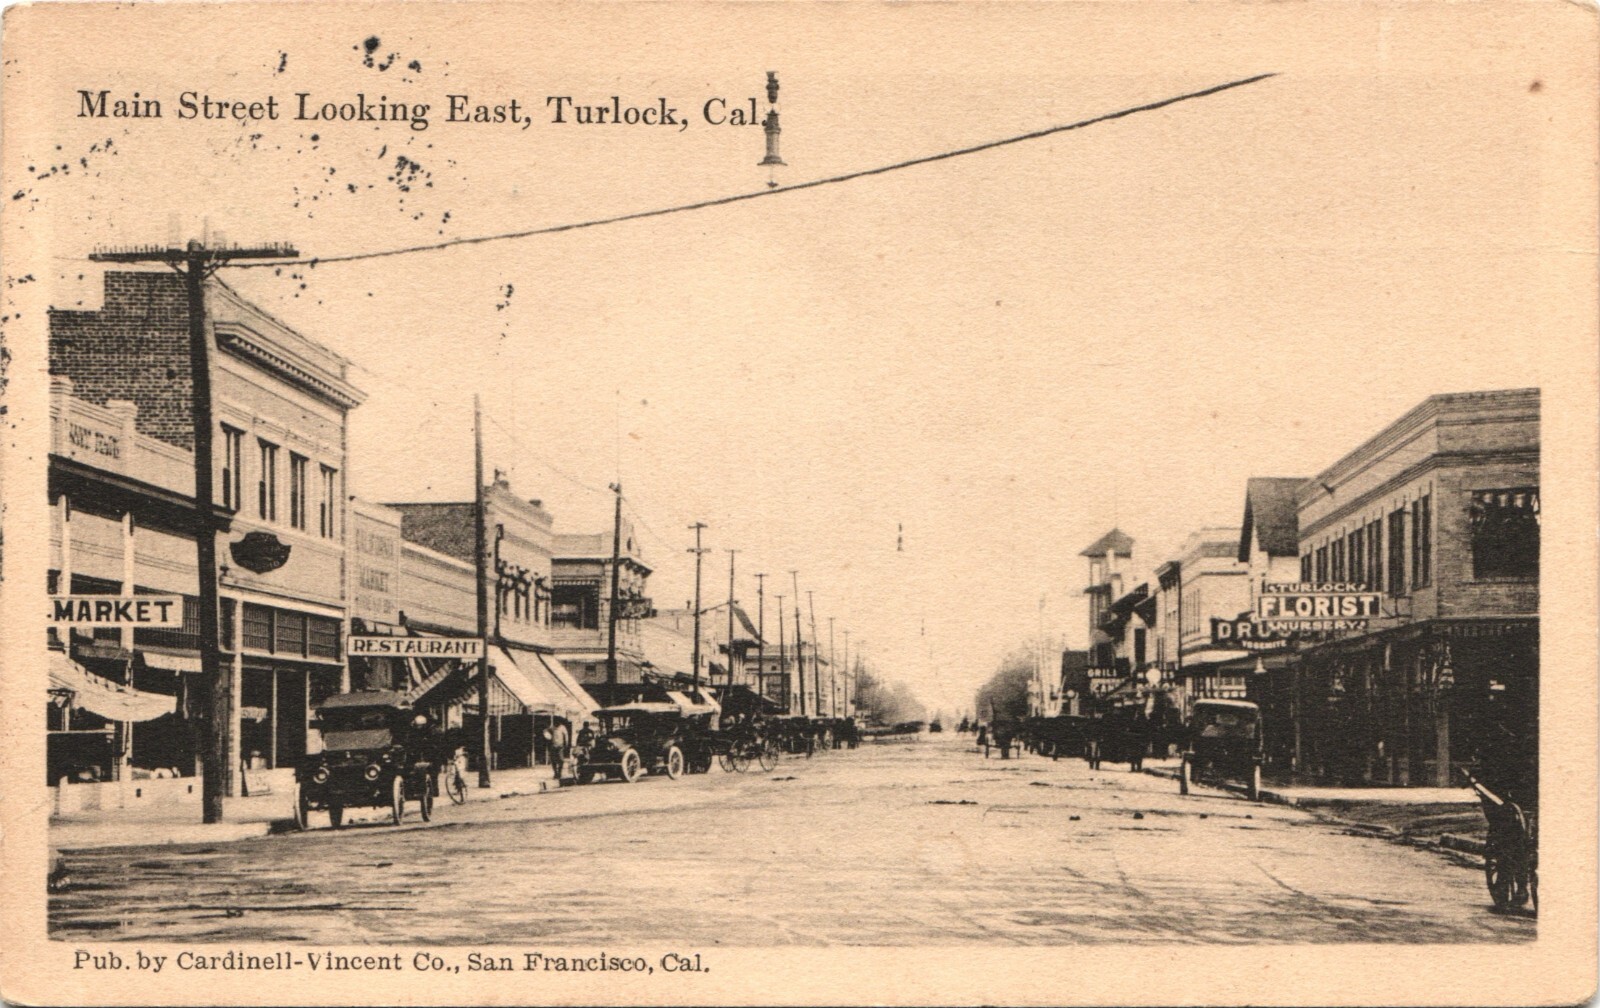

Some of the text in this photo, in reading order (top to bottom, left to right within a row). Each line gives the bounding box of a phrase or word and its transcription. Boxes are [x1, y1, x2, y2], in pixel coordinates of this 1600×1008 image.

[1278, 582, 1357, 593] TURLOCK
[54, 599, 174, 622] MARKET
[1261, 596, 1375, 617] FLORIST
[1278, 620, 1355, 631] NURSERY
[353, 639, 480, 654] RESTAURANT
